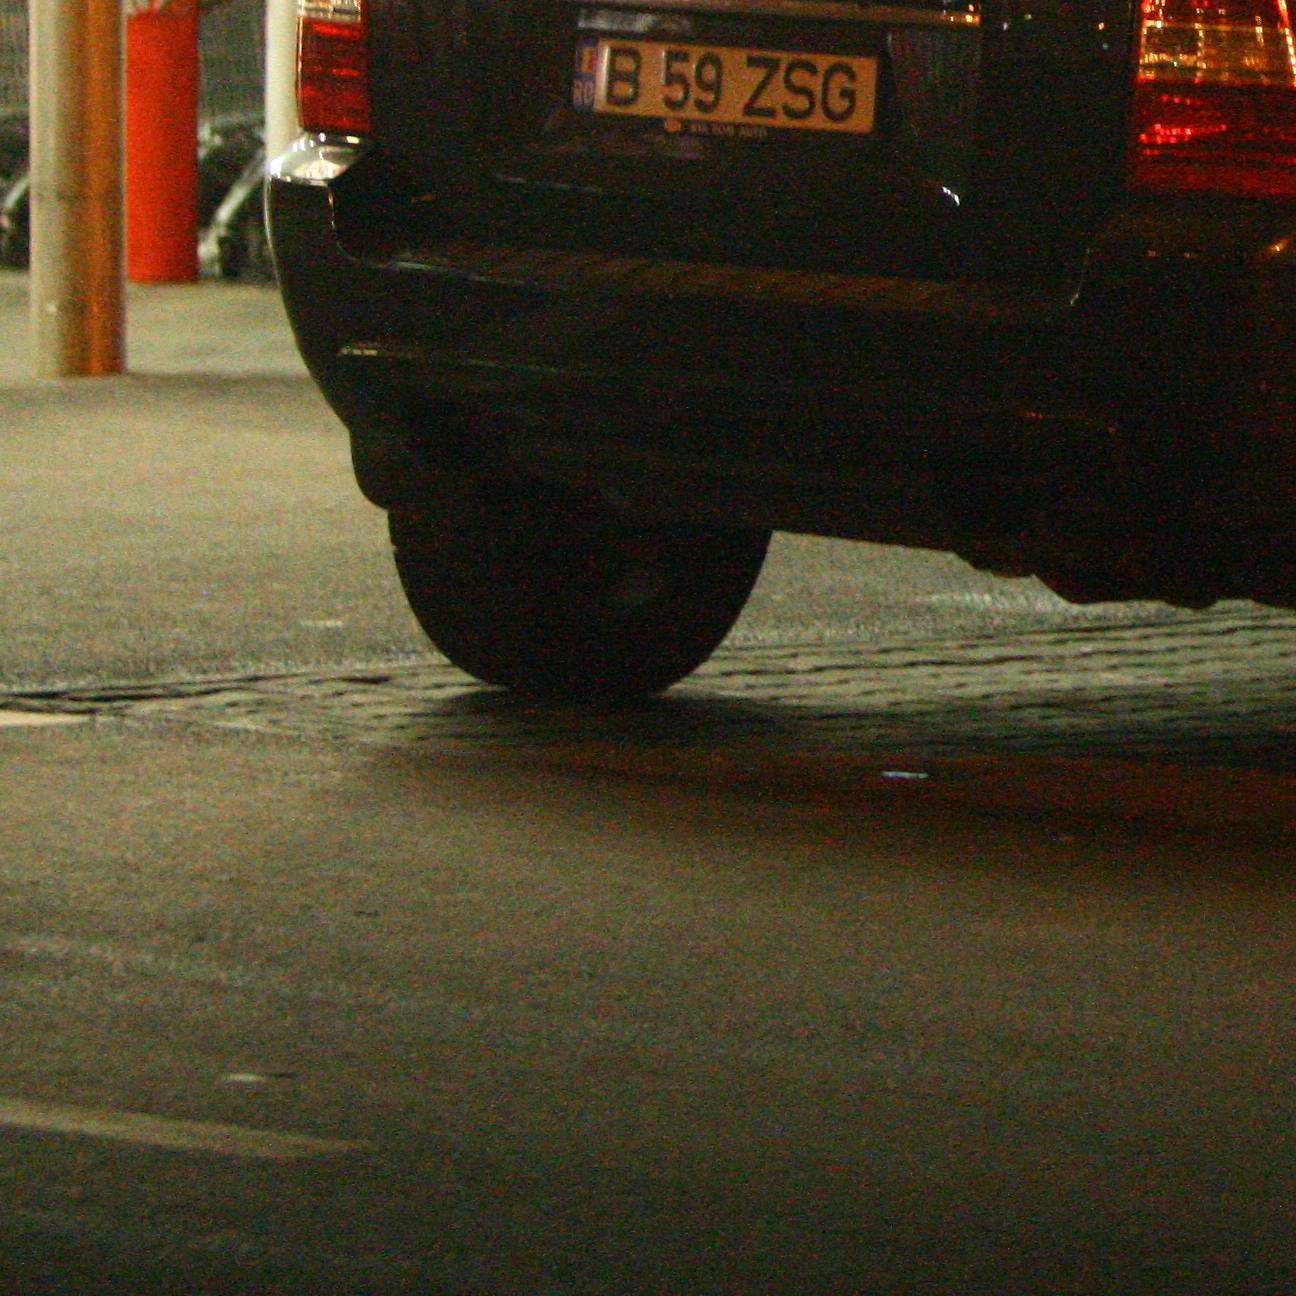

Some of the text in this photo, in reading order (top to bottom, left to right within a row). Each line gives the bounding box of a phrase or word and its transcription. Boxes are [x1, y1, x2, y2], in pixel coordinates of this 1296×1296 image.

[605, 47, 858, 122] B 59 ZSG
